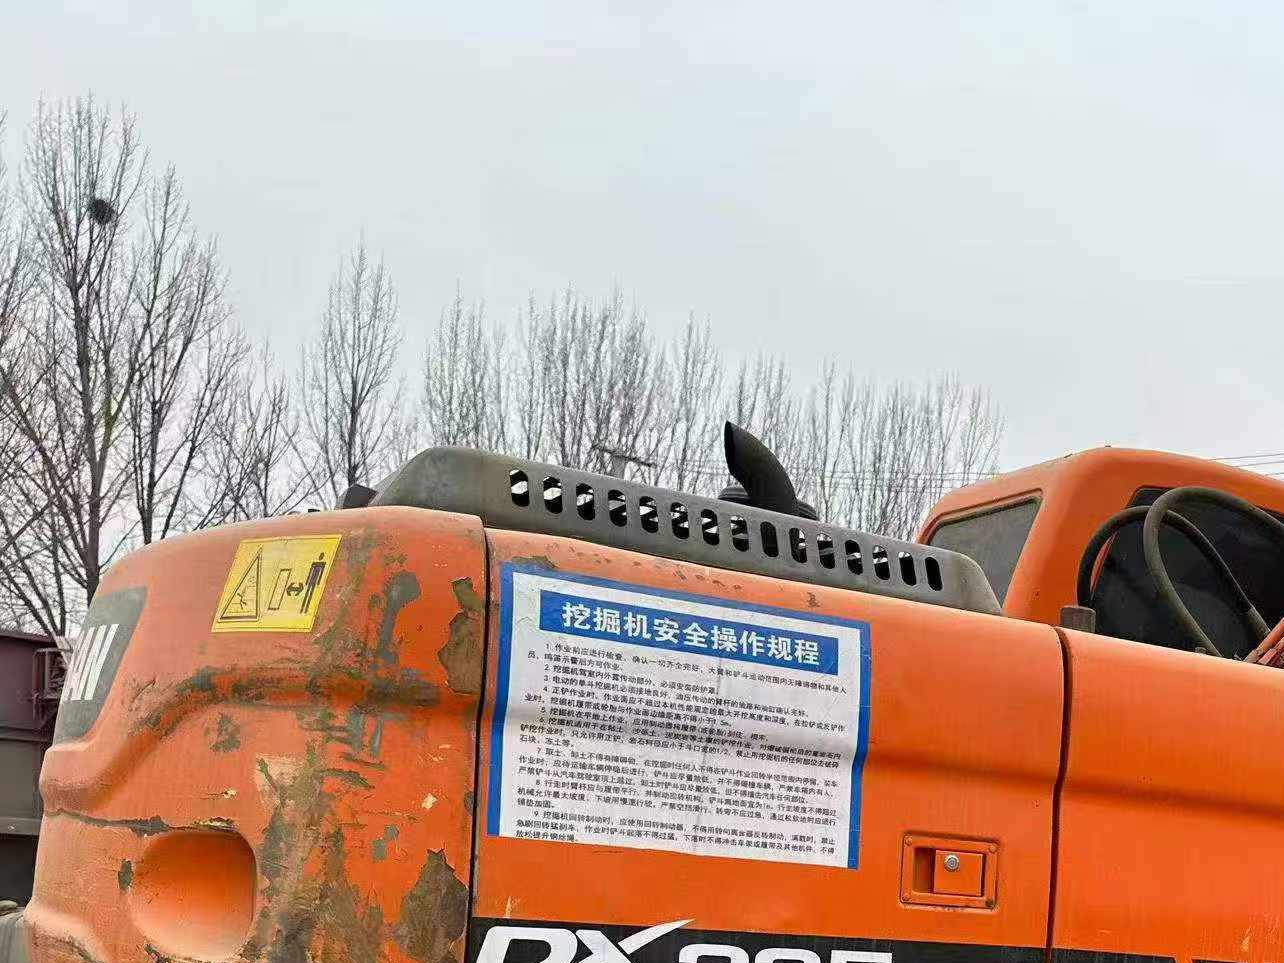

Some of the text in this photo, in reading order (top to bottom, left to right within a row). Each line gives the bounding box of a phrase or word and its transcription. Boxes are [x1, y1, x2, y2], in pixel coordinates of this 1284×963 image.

[561, 601, 821, 666] 挖掘机安全操作规程
